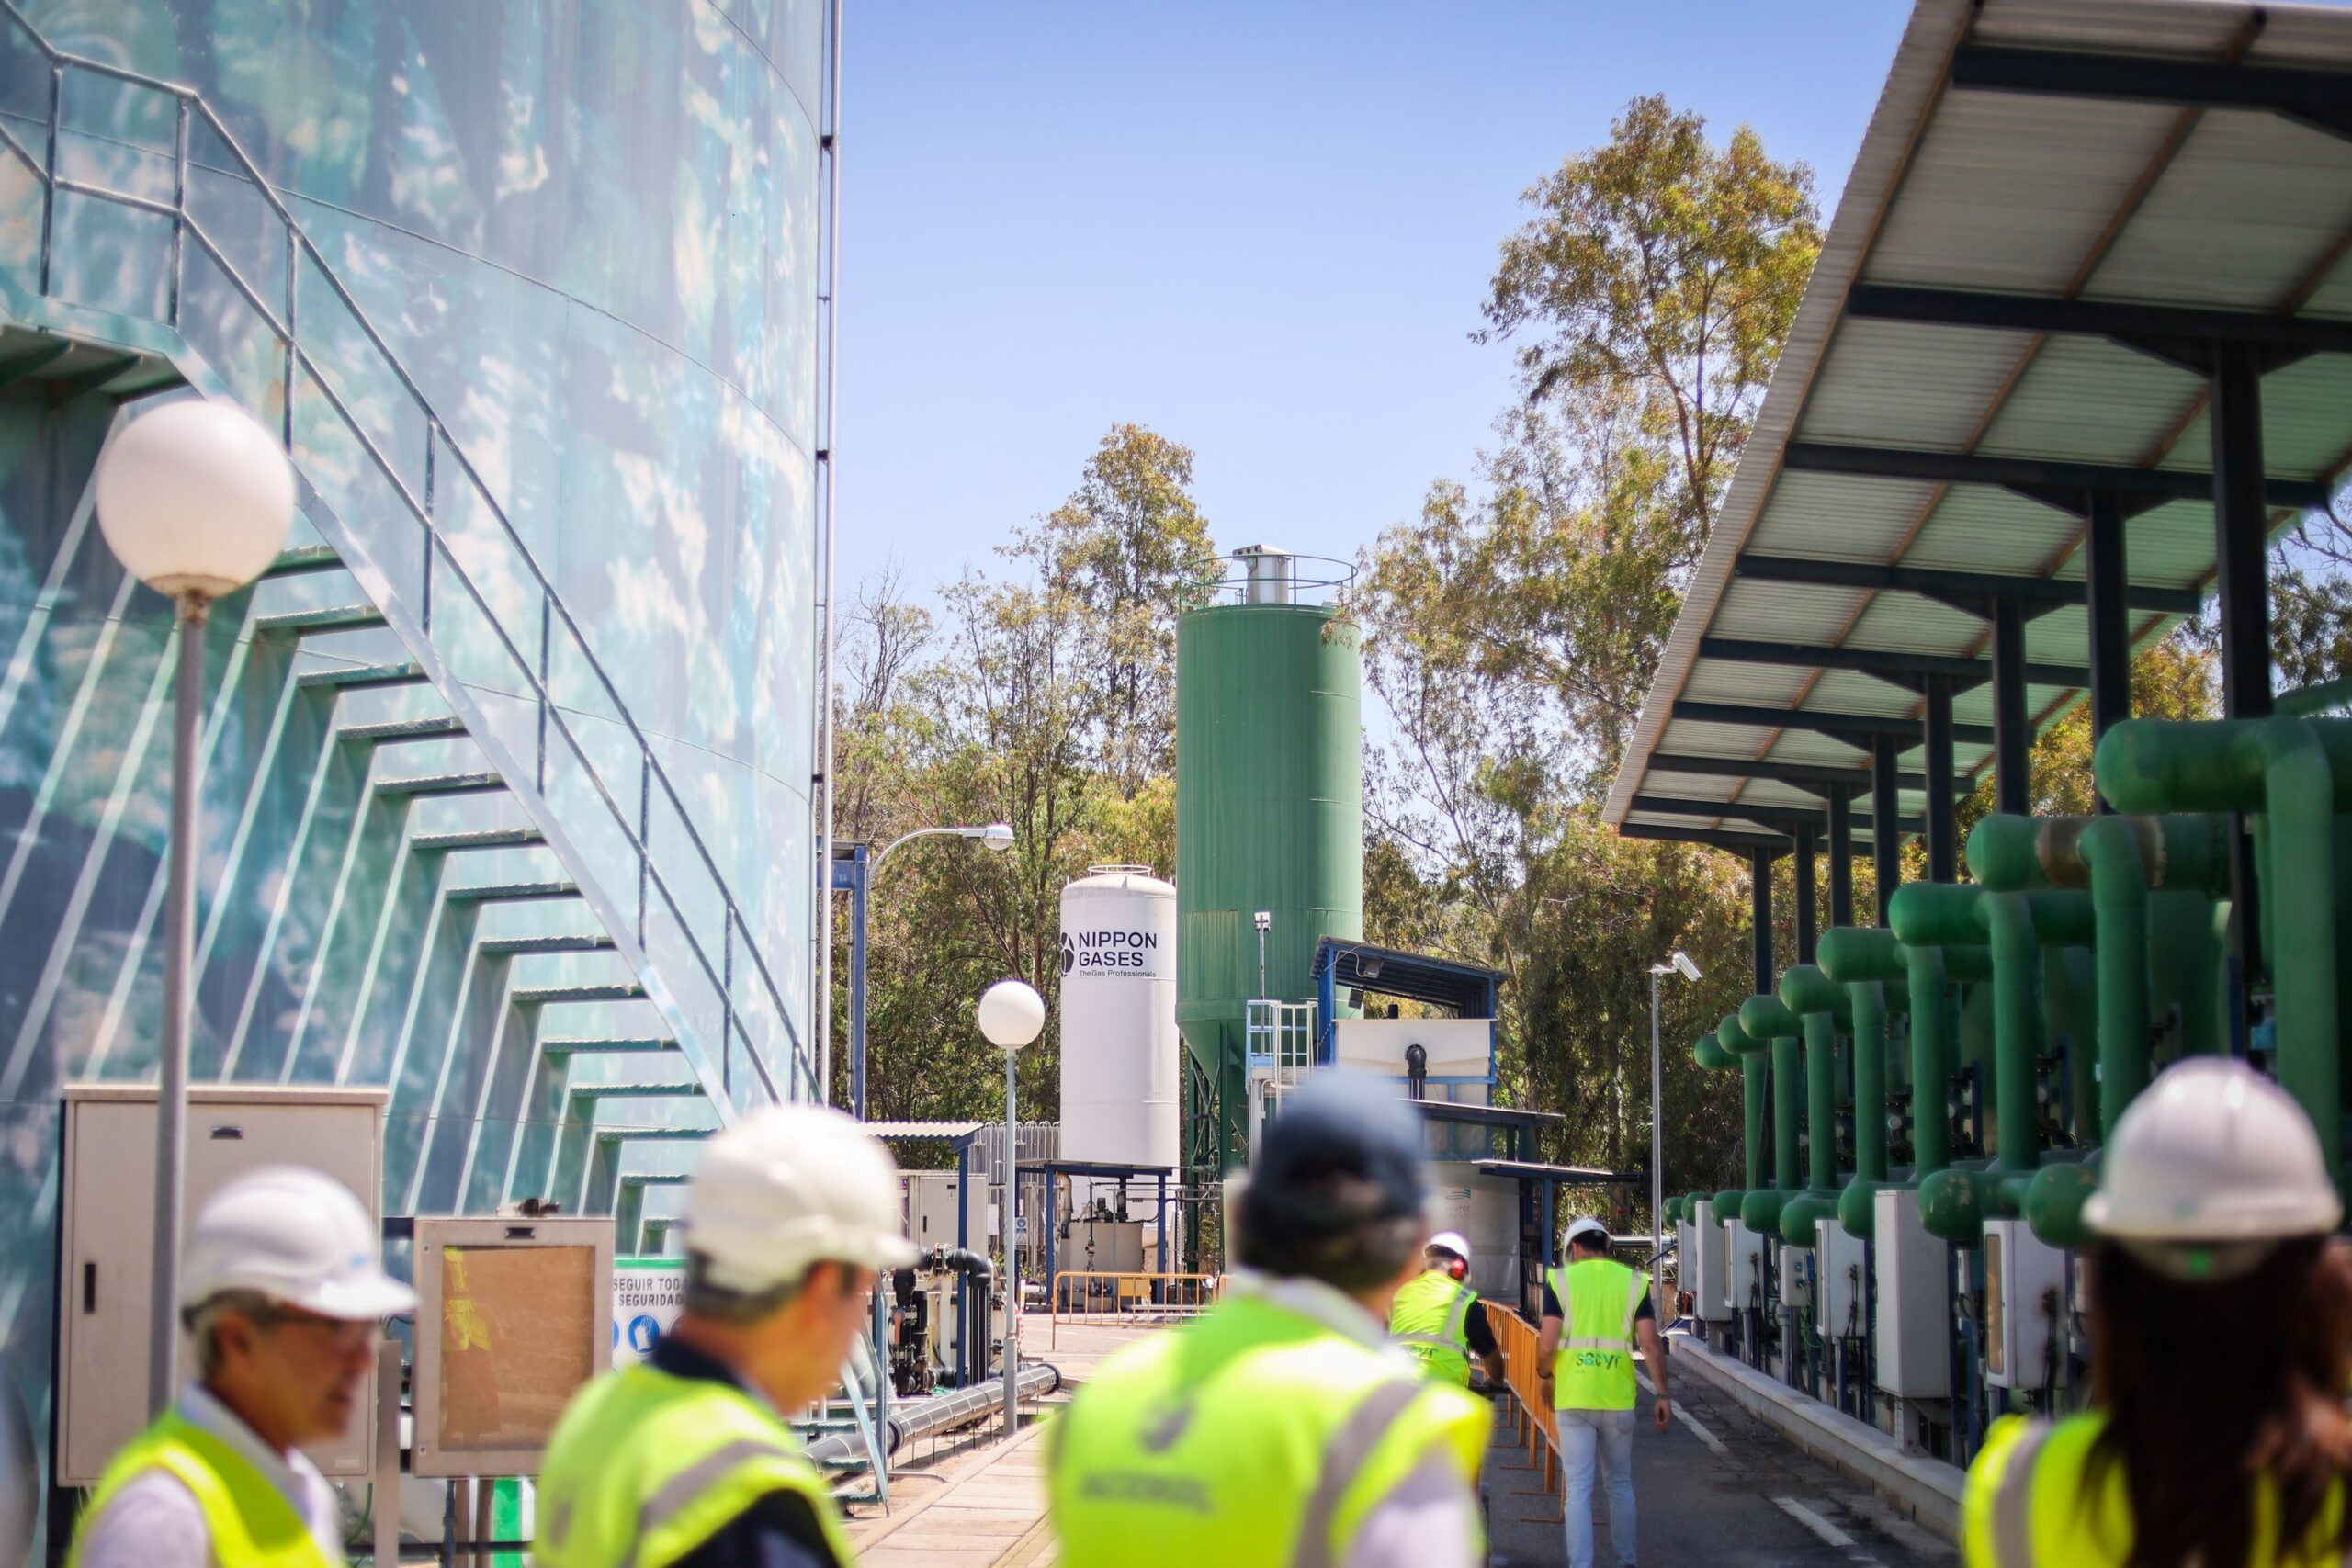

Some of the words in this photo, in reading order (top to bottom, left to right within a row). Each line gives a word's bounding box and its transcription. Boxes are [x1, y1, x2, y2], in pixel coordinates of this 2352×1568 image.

[1079, 931, 1157, 949] NIPPON
[1079, 951, 1144, 967] GASES
[1107, 969, 1156, 977] Professionals
[613, 1278, 653, 1292] SEGUIR
[618, 1294, 684, 1306] SEGURIDAD
[1576, 1352, 1622, 1370] sacyr
